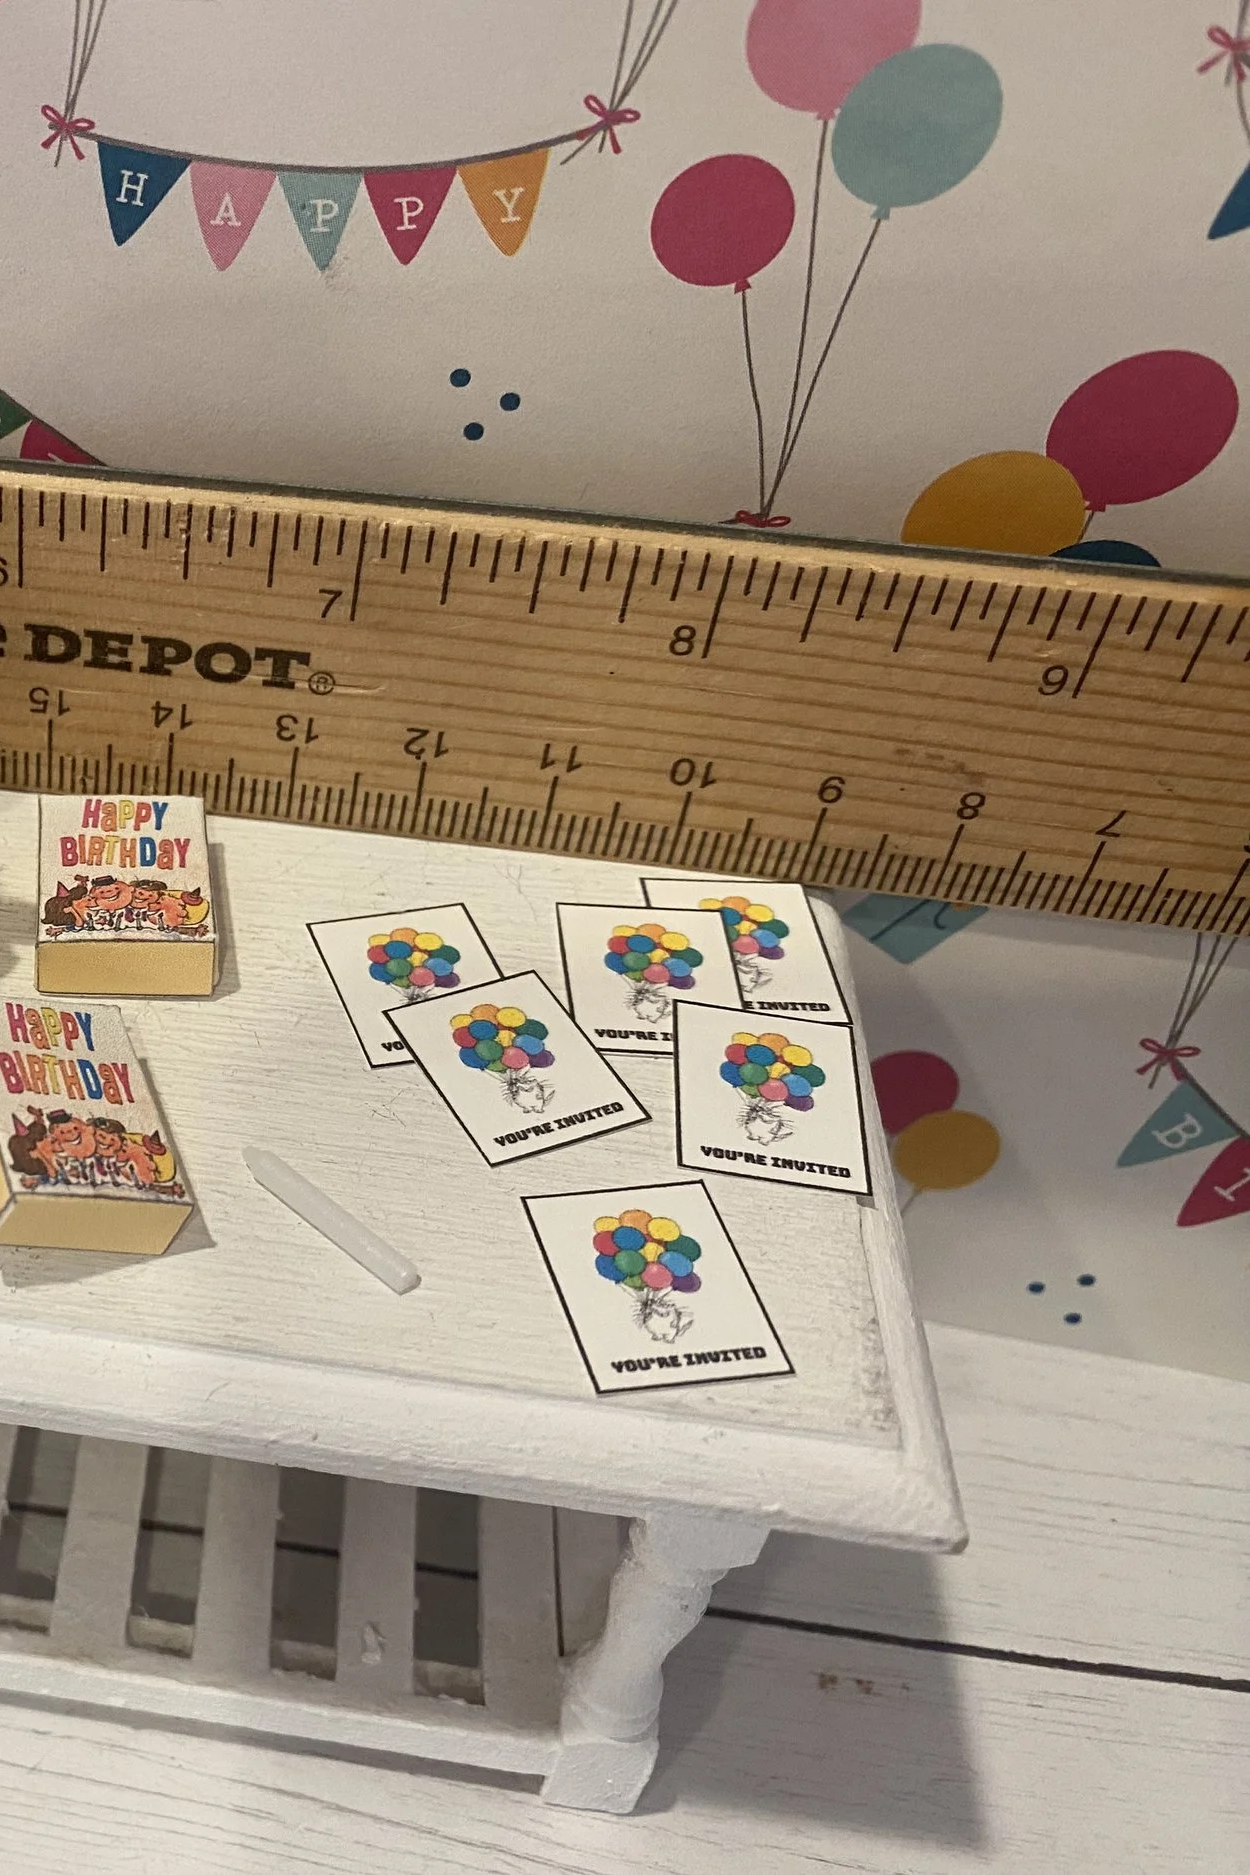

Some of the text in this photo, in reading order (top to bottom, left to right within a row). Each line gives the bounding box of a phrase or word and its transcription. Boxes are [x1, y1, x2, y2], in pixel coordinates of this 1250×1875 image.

[116, 170, 526, 232] HAPPY
[318, 589, 343, 619] 7
[669, 624, 697, 657] 8
[1038, 664, 1069, 697] 9
[29, 686, 71, 717] 15
[153, 701, 194, 729] 14
[275, 714, 320, 744] 13
[403, 727, 450, 759] 12
[539, 743, 583, 773] 11
[669, 758, 718, 789] 10
[817, 776, 846, 804] 9
[956, 792, 986, 821] 8
[1094, 810, 1128, 838] 7
[756, 1000, 831, 1012] INVITED
[593, 1028, 659, 1041] YOU'RE
[493, 1101, 625, 1147] YOU'RE INVITED
[700, 1145, 852, 1178] YOU'RE INVITED
[611, 1346, 768, 1373] YOU'RE INVITED
